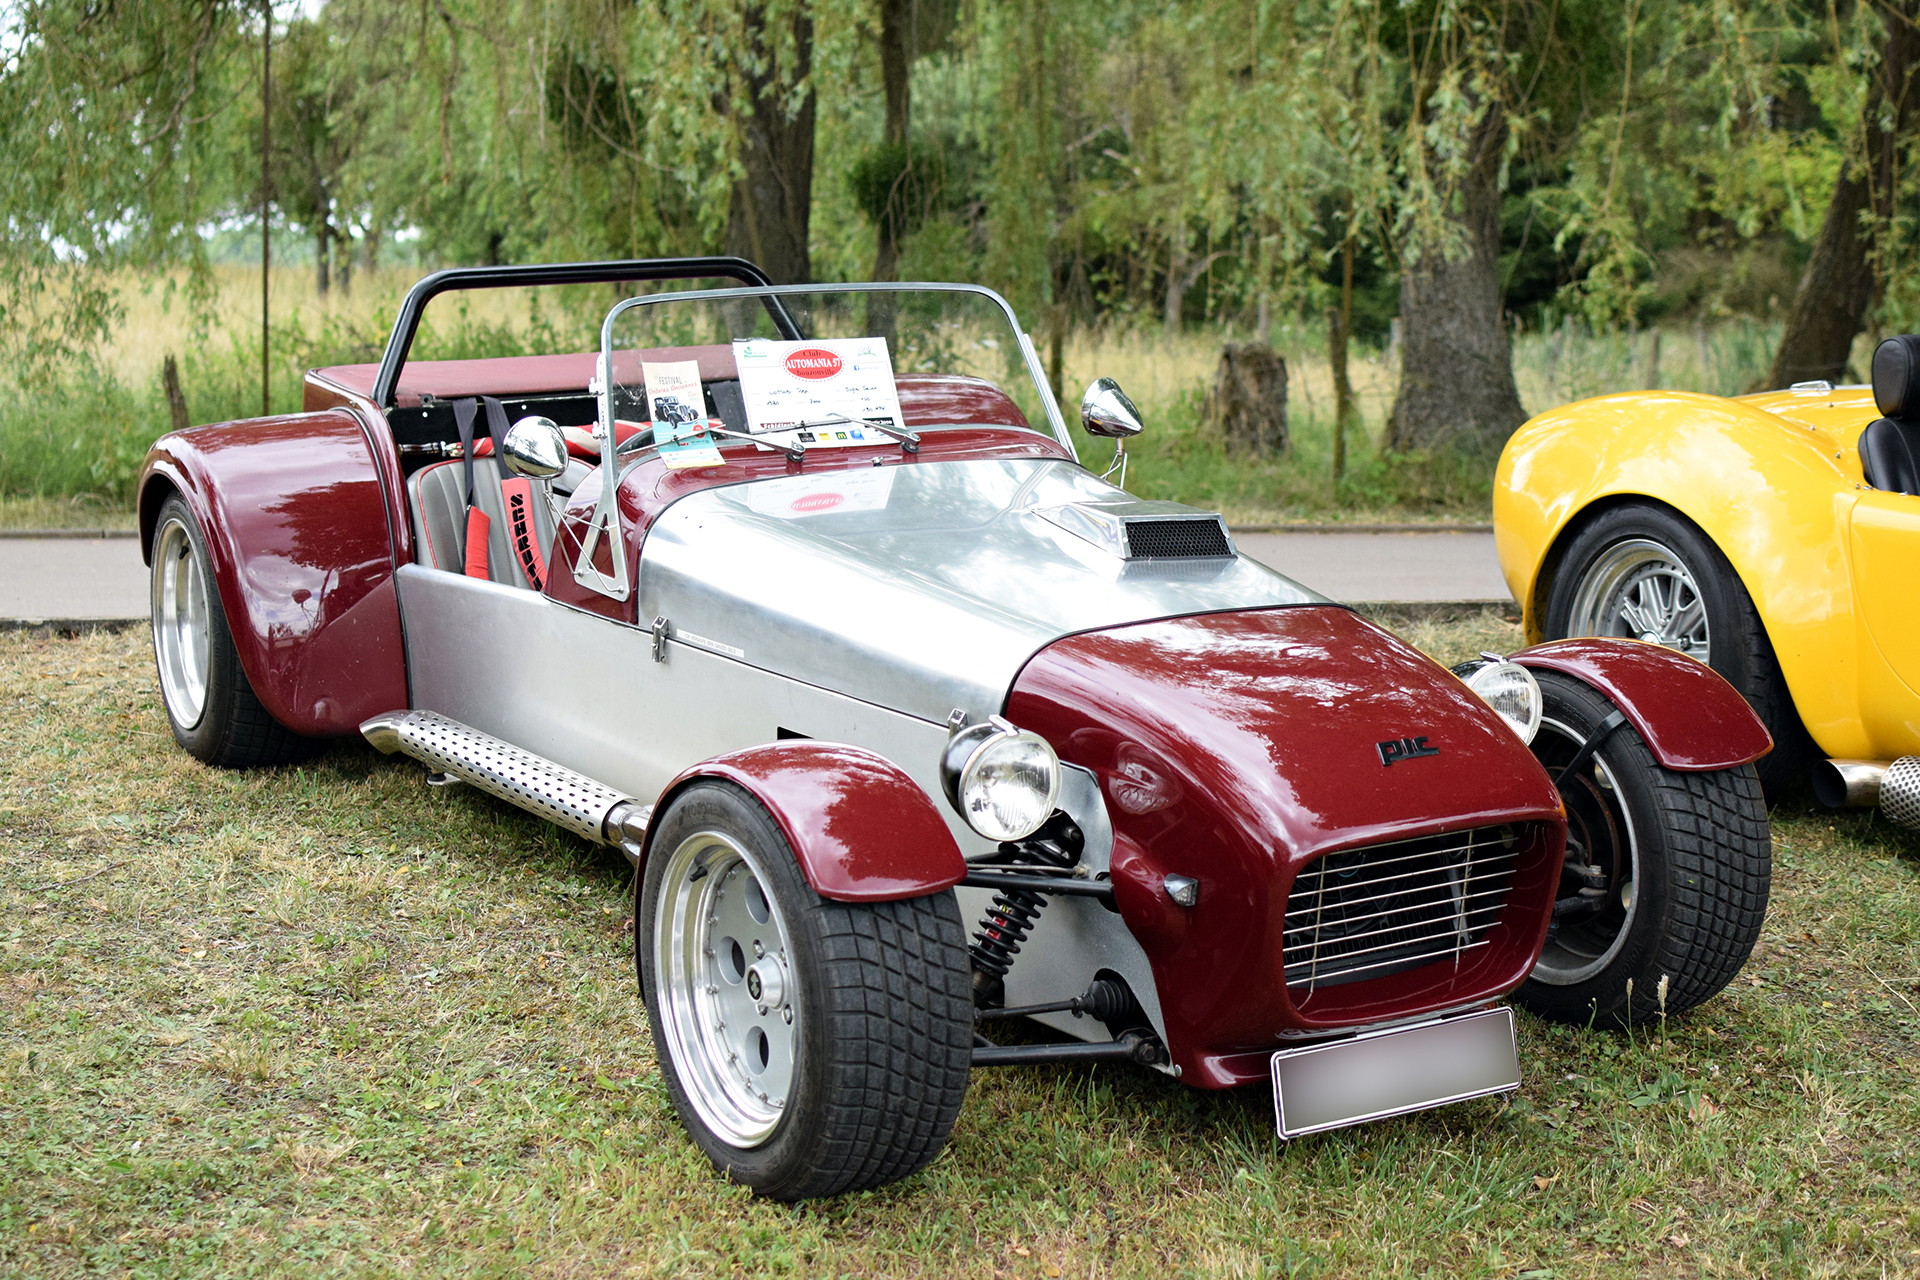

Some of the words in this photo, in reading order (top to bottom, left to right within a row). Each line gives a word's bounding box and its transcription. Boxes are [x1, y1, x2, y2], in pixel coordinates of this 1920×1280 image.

[786, 357, 832, 369] AUTOMANIA
[832, 357, 841, 367] 57
[658, 376, 682, 385] FESTIVAL
